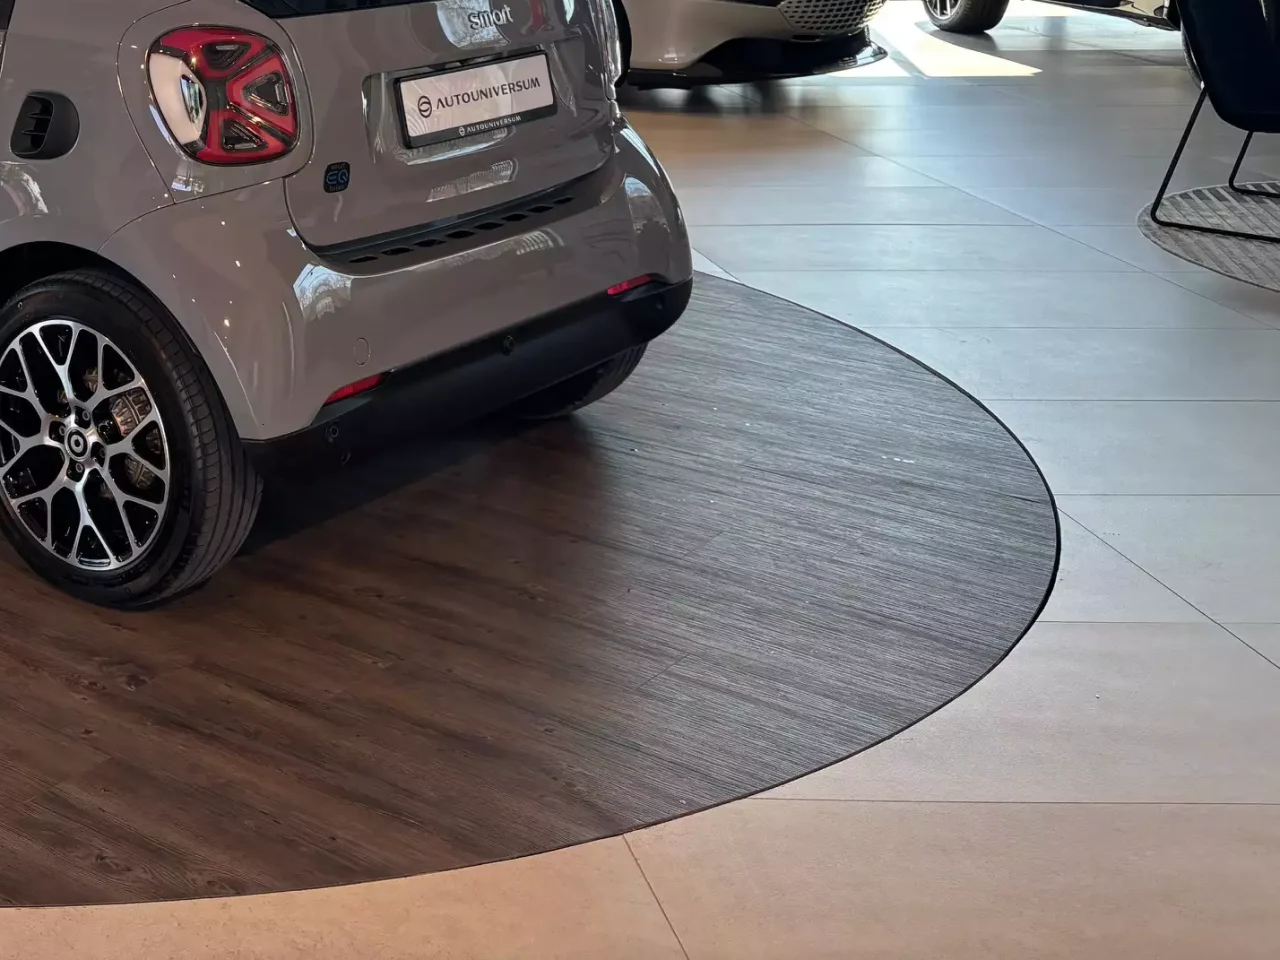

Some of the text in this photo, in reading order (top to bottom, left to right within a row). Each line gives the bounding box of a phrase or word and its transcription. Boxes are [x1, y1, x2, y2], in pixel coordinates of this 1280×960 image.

[468, 4, 513, 30] smart
[436, 77, 541, 110] AUTOUNIVERSUM
[466, 115, 522, 134] AUTOUNIVERSUM
[326, 170, 348, 184] EQ
